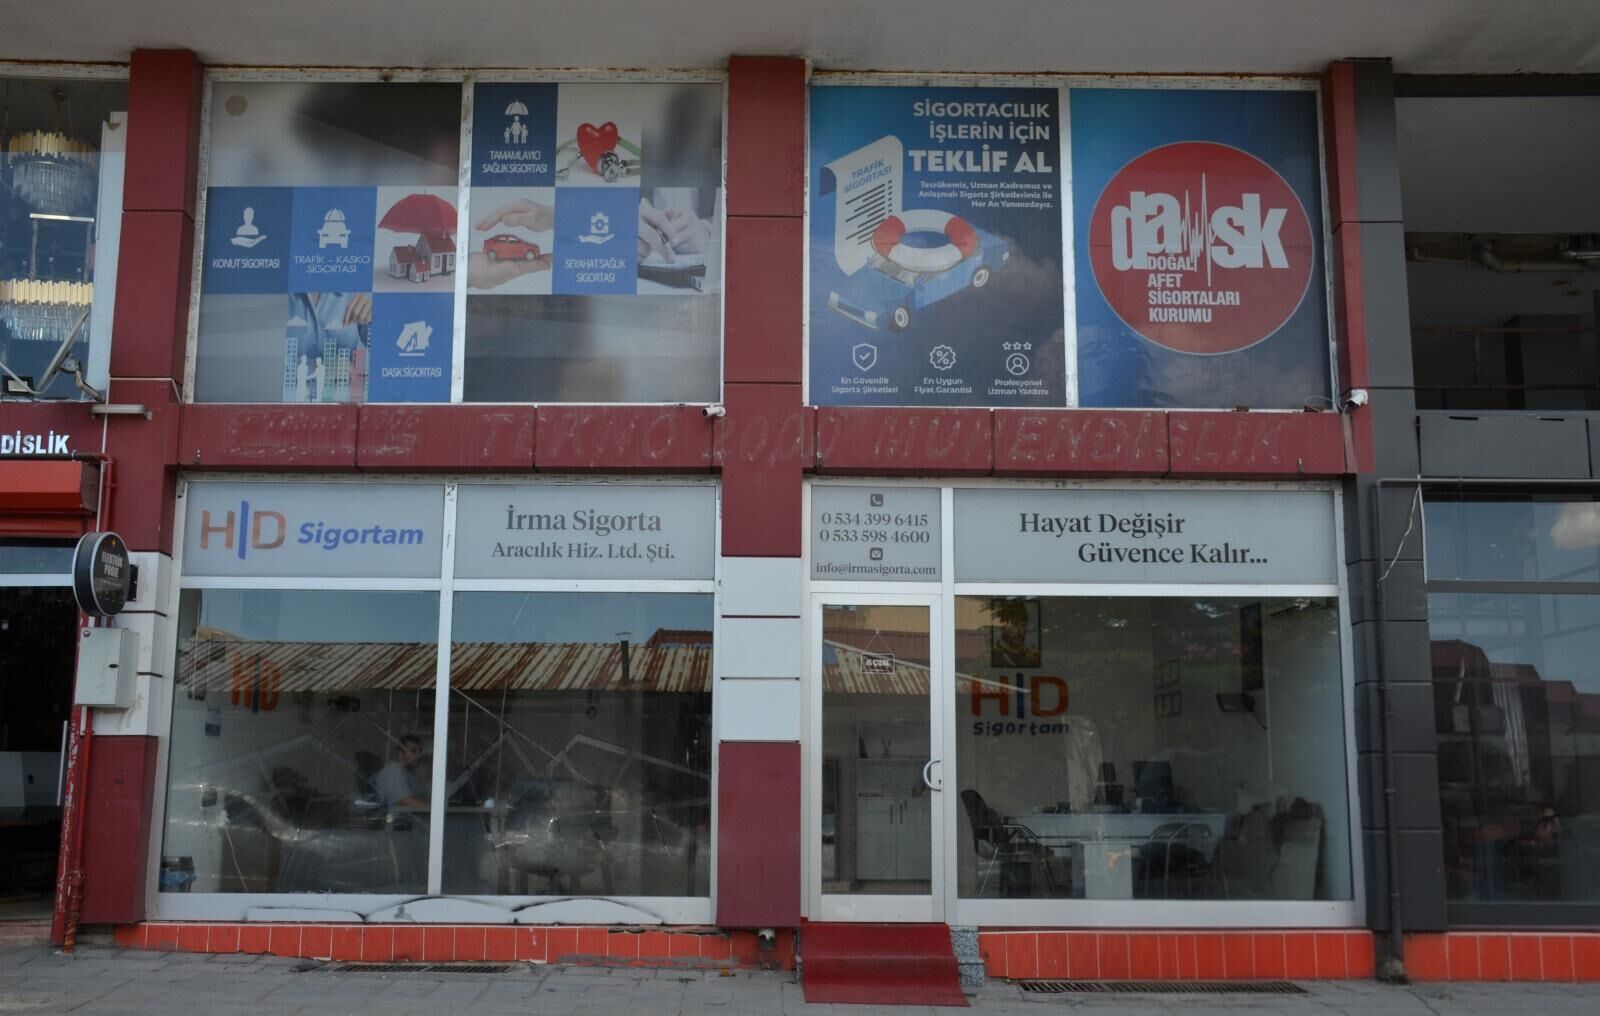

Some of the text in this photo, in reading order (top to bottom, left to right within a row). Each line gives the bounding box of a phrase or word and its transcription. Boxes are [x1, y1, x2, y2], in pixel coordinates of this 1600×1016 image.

[913, 98, 1050, 118] SİGORTACILIK
[929, 120, 1050, 144] İŞLERİN İÇİN
[489, 150, 541, 160] TAMAMLAYICI
[908, 144, 1052, 173] TEKLİF AL
[920, 181, 969, 190] Tecrübemiz,
[1000, 181, 1040, 190] Kadromuz
[919, 190, 958, 199] Anlaşmalı
[960, 191, 989, 199] Sigorta
[990, 191, 1040, 199] Şirketlerimiz
[971, 200, 1054, 210] Her An Yanınızdayız.
[212, 256, 280, 268] KONUT SİGORTASI
[294, 254, 325, 264] TRAFİK
[336, 255, 370, 264] KASKO
[564, 259, 598, 269] SEYAHAT
[1147, 252, 1194, 271] DOĞAL
[306, 263, 357, 273] SİGORTASI
[1147, 273, 1183, 287] AFET
[1148, 287, 1240, 305] SİGORTALARI
[1149, 308, 1212, 322] KURUMU
[381, 365, 442, 377] DASK SİGORTASI
[936, 377, 963, 386] Uygun
[994, 379, 1042, 387] Profesyonel
[831, 386, 860, 395] Sigorta
[914, 386, 934, 394] Fiyat
[1, 430, 70, 454] DİSLİK
[506, 504, 661, 537] İrma Sigorta
[821, 512, 928, 527] 0 534 399 6415
[1019, 512, 1185, 539] Hayat Değişir
[297, 522, 424, 550] Sigortam
[820, 529, 930, 543] 0 533 598 4600
[492, 541, 675, 563] Aracılık Hiz. Ltd. Şti.
[1078, 542, 1268, 564] Güvence Kalır...
[816, 562, 936, 576] info@irmasigorta.com
[973, 721, 1069, 736] Sigortam
